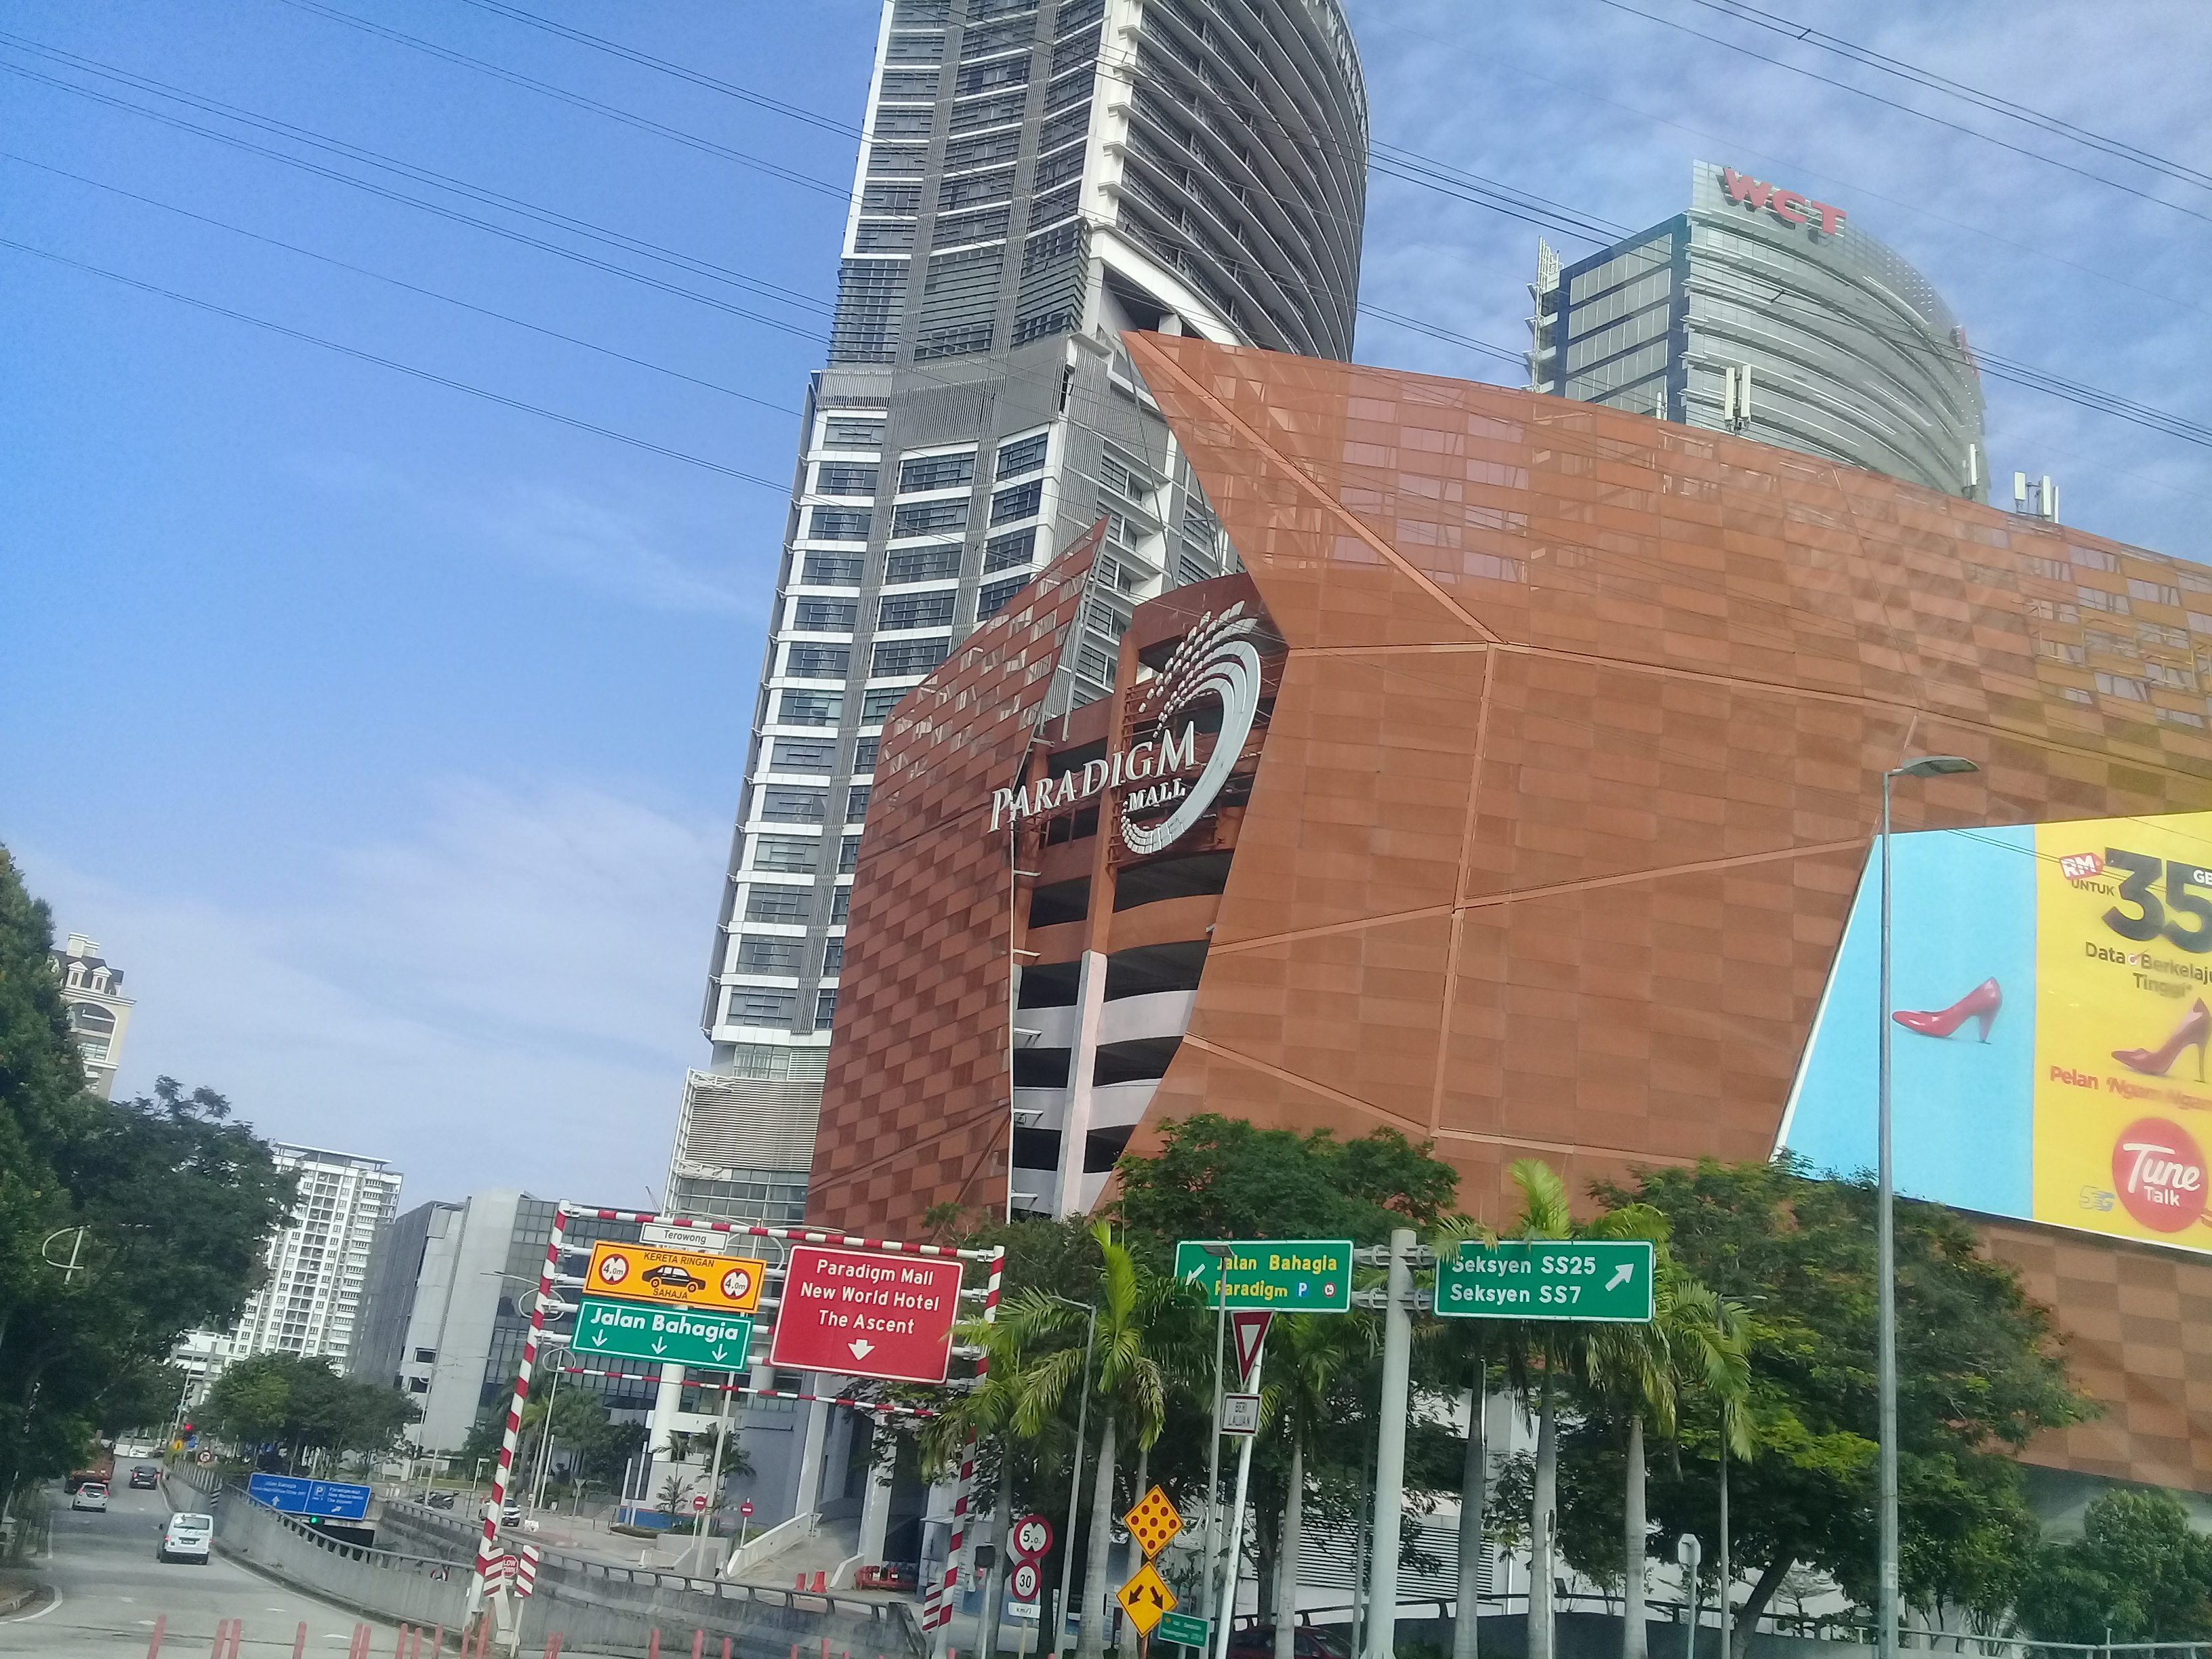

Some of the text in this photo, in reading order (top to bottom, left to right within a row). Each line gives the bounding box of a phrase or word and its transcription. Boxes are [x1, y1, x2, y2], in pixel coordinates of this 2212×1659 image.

[1722, 167, 1847, 235] WCT
[987, 721, 1197, 834] PARADIGM
[1127, 778, 1185, 813] MALL
[2060, 855, 2097, 878] RM
[2071, 879, 2115, 897] UNTUK
[2102, 846, 2212, 954] 35
[2085, 941, 2126, 965] Data
[2050, 1065, 2100, 1090] Pelan
[2123, 1143, 2201, 1194] Tune
[2143, 1185, 2180, 1207] Talk
[663, 1229, 707, 1244] Terowong
[602, 1263, 623, 1275] 4.0m
[644, 1252, 715, 1267] KERETA RINGAN
[1269, 1254, 1337, 1275] Bahagia
[1452, 1256, 1596, 1277] Seksyen SS25
[816, 1258, 934, 1286] Paradigm Mall
[653, 1288, 688, 1300] SAHAJA
[725, 1277, 746, 1290] 4.0m
[1214, 1279, 1288, 1300] Paradigm
[1450, 1284, 1581, 1305] Seksyen SS7
[800, 1282, 940, 1311] New World Hotel
[590, 1307, 739, 1343] Jalan Bahagia
[819, 1309, 915, 1334] The Ascent
[1019, 1574, 1031, 1589] 30
